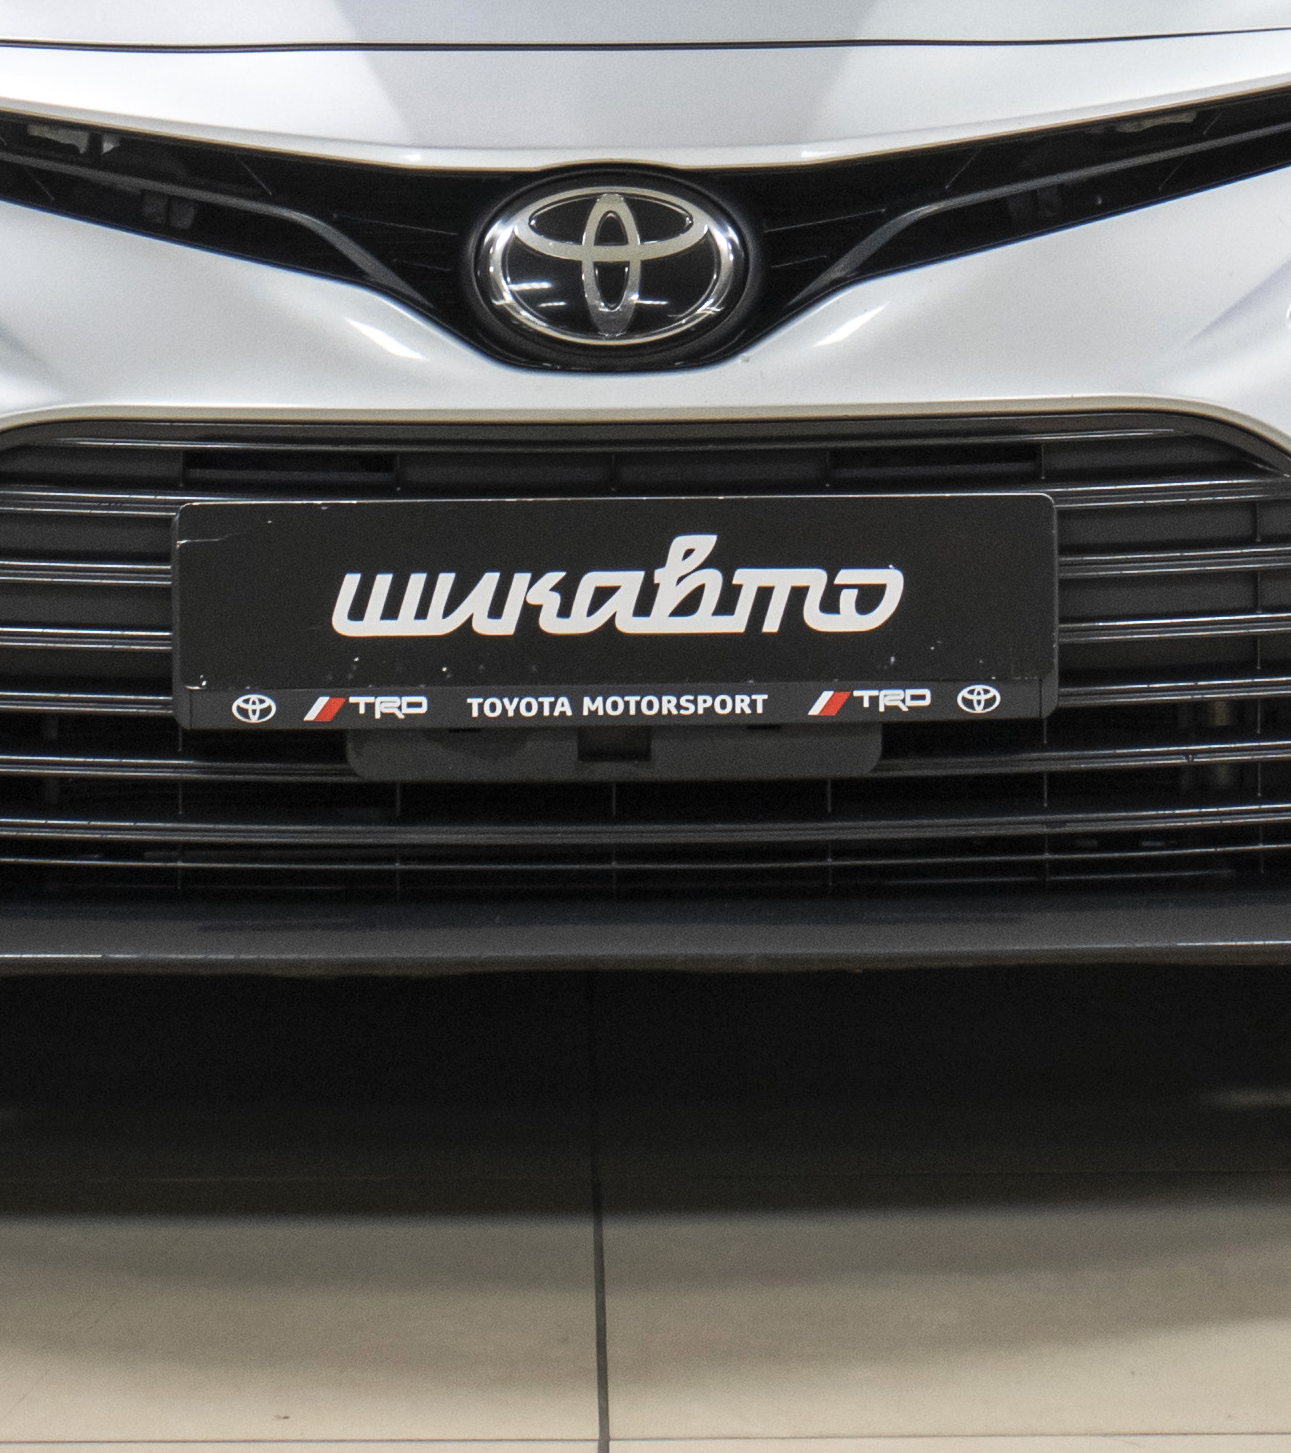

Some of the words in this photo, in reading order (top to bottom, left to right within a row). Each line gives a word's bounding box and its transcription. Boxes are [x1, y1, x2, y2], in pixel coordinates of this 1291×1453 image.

[348, 696, 428, 719] TRD
[466, 696, 574, 718] TOYOTA
[582, 694, 769, 716] MOTORSPORT
[852, 688, 932, 712] TRD
